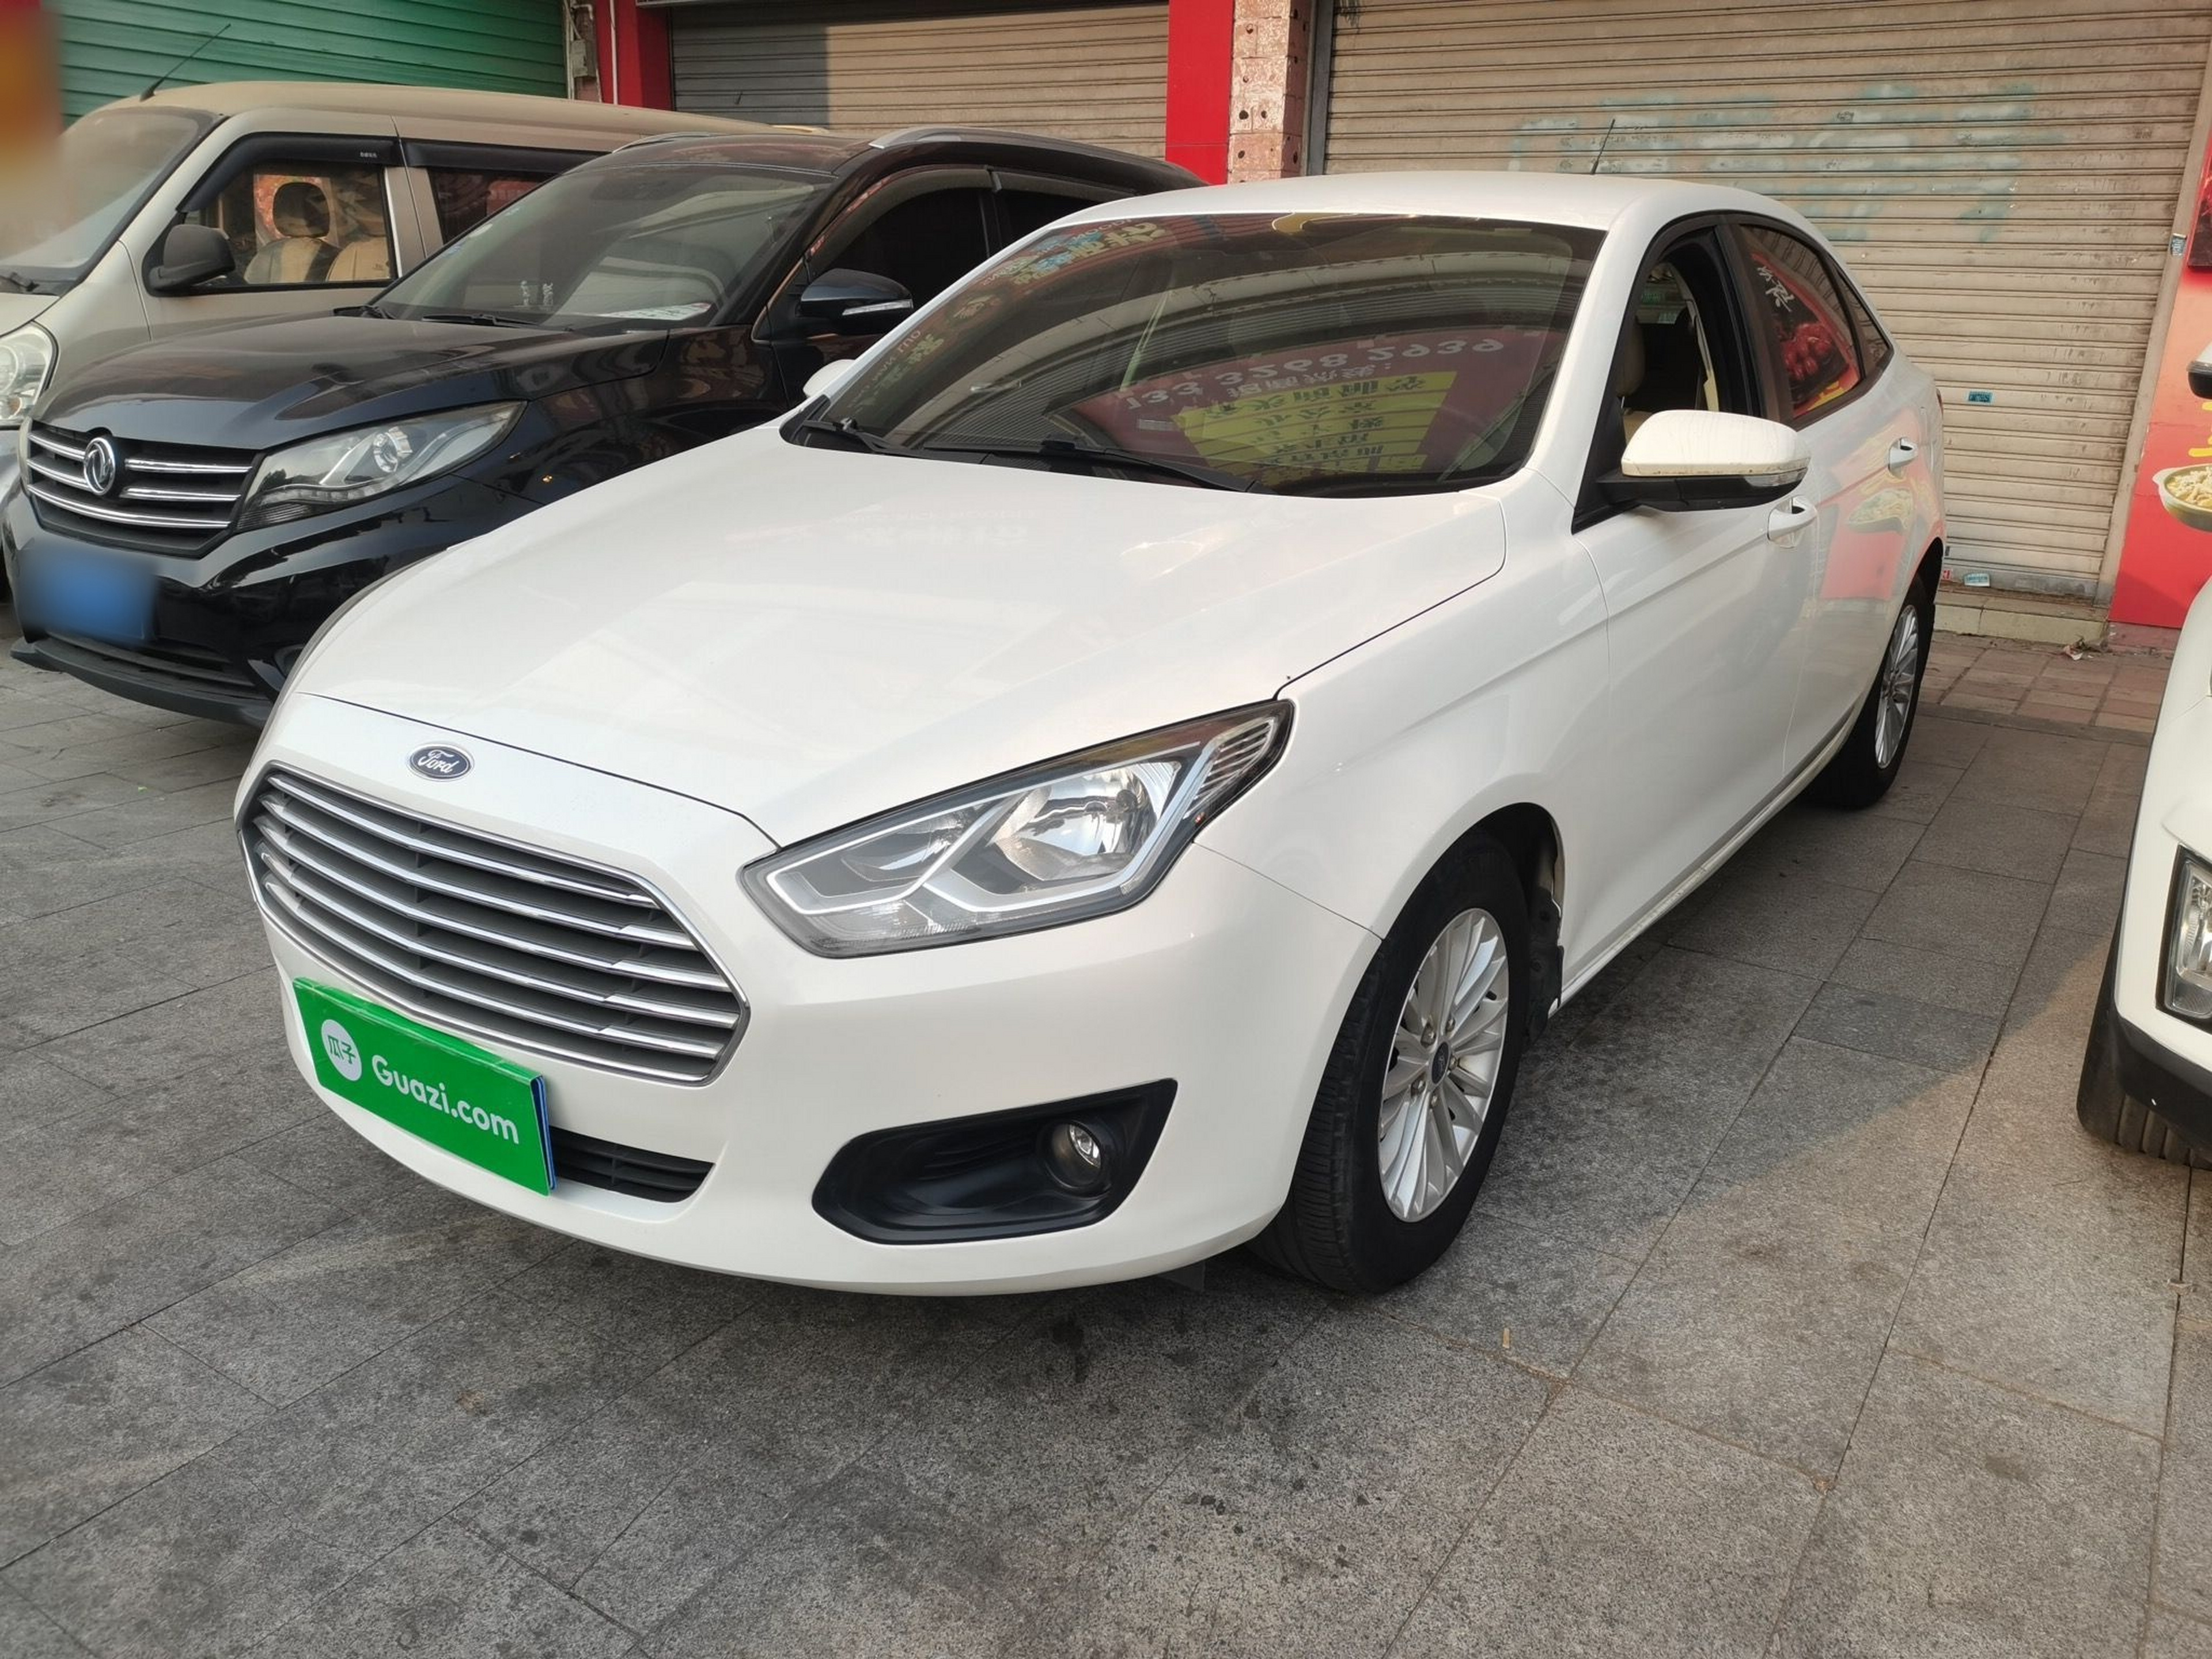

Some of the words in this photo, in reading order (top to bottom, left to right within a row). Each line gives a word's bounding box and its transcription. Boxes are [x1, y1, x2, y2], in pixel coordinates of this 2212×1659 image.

[418, 748, 460, 775] Ford
[327, 1036, 358, 1065] 瓜子
[372, 1054, 520, 1145] Guazi.com
